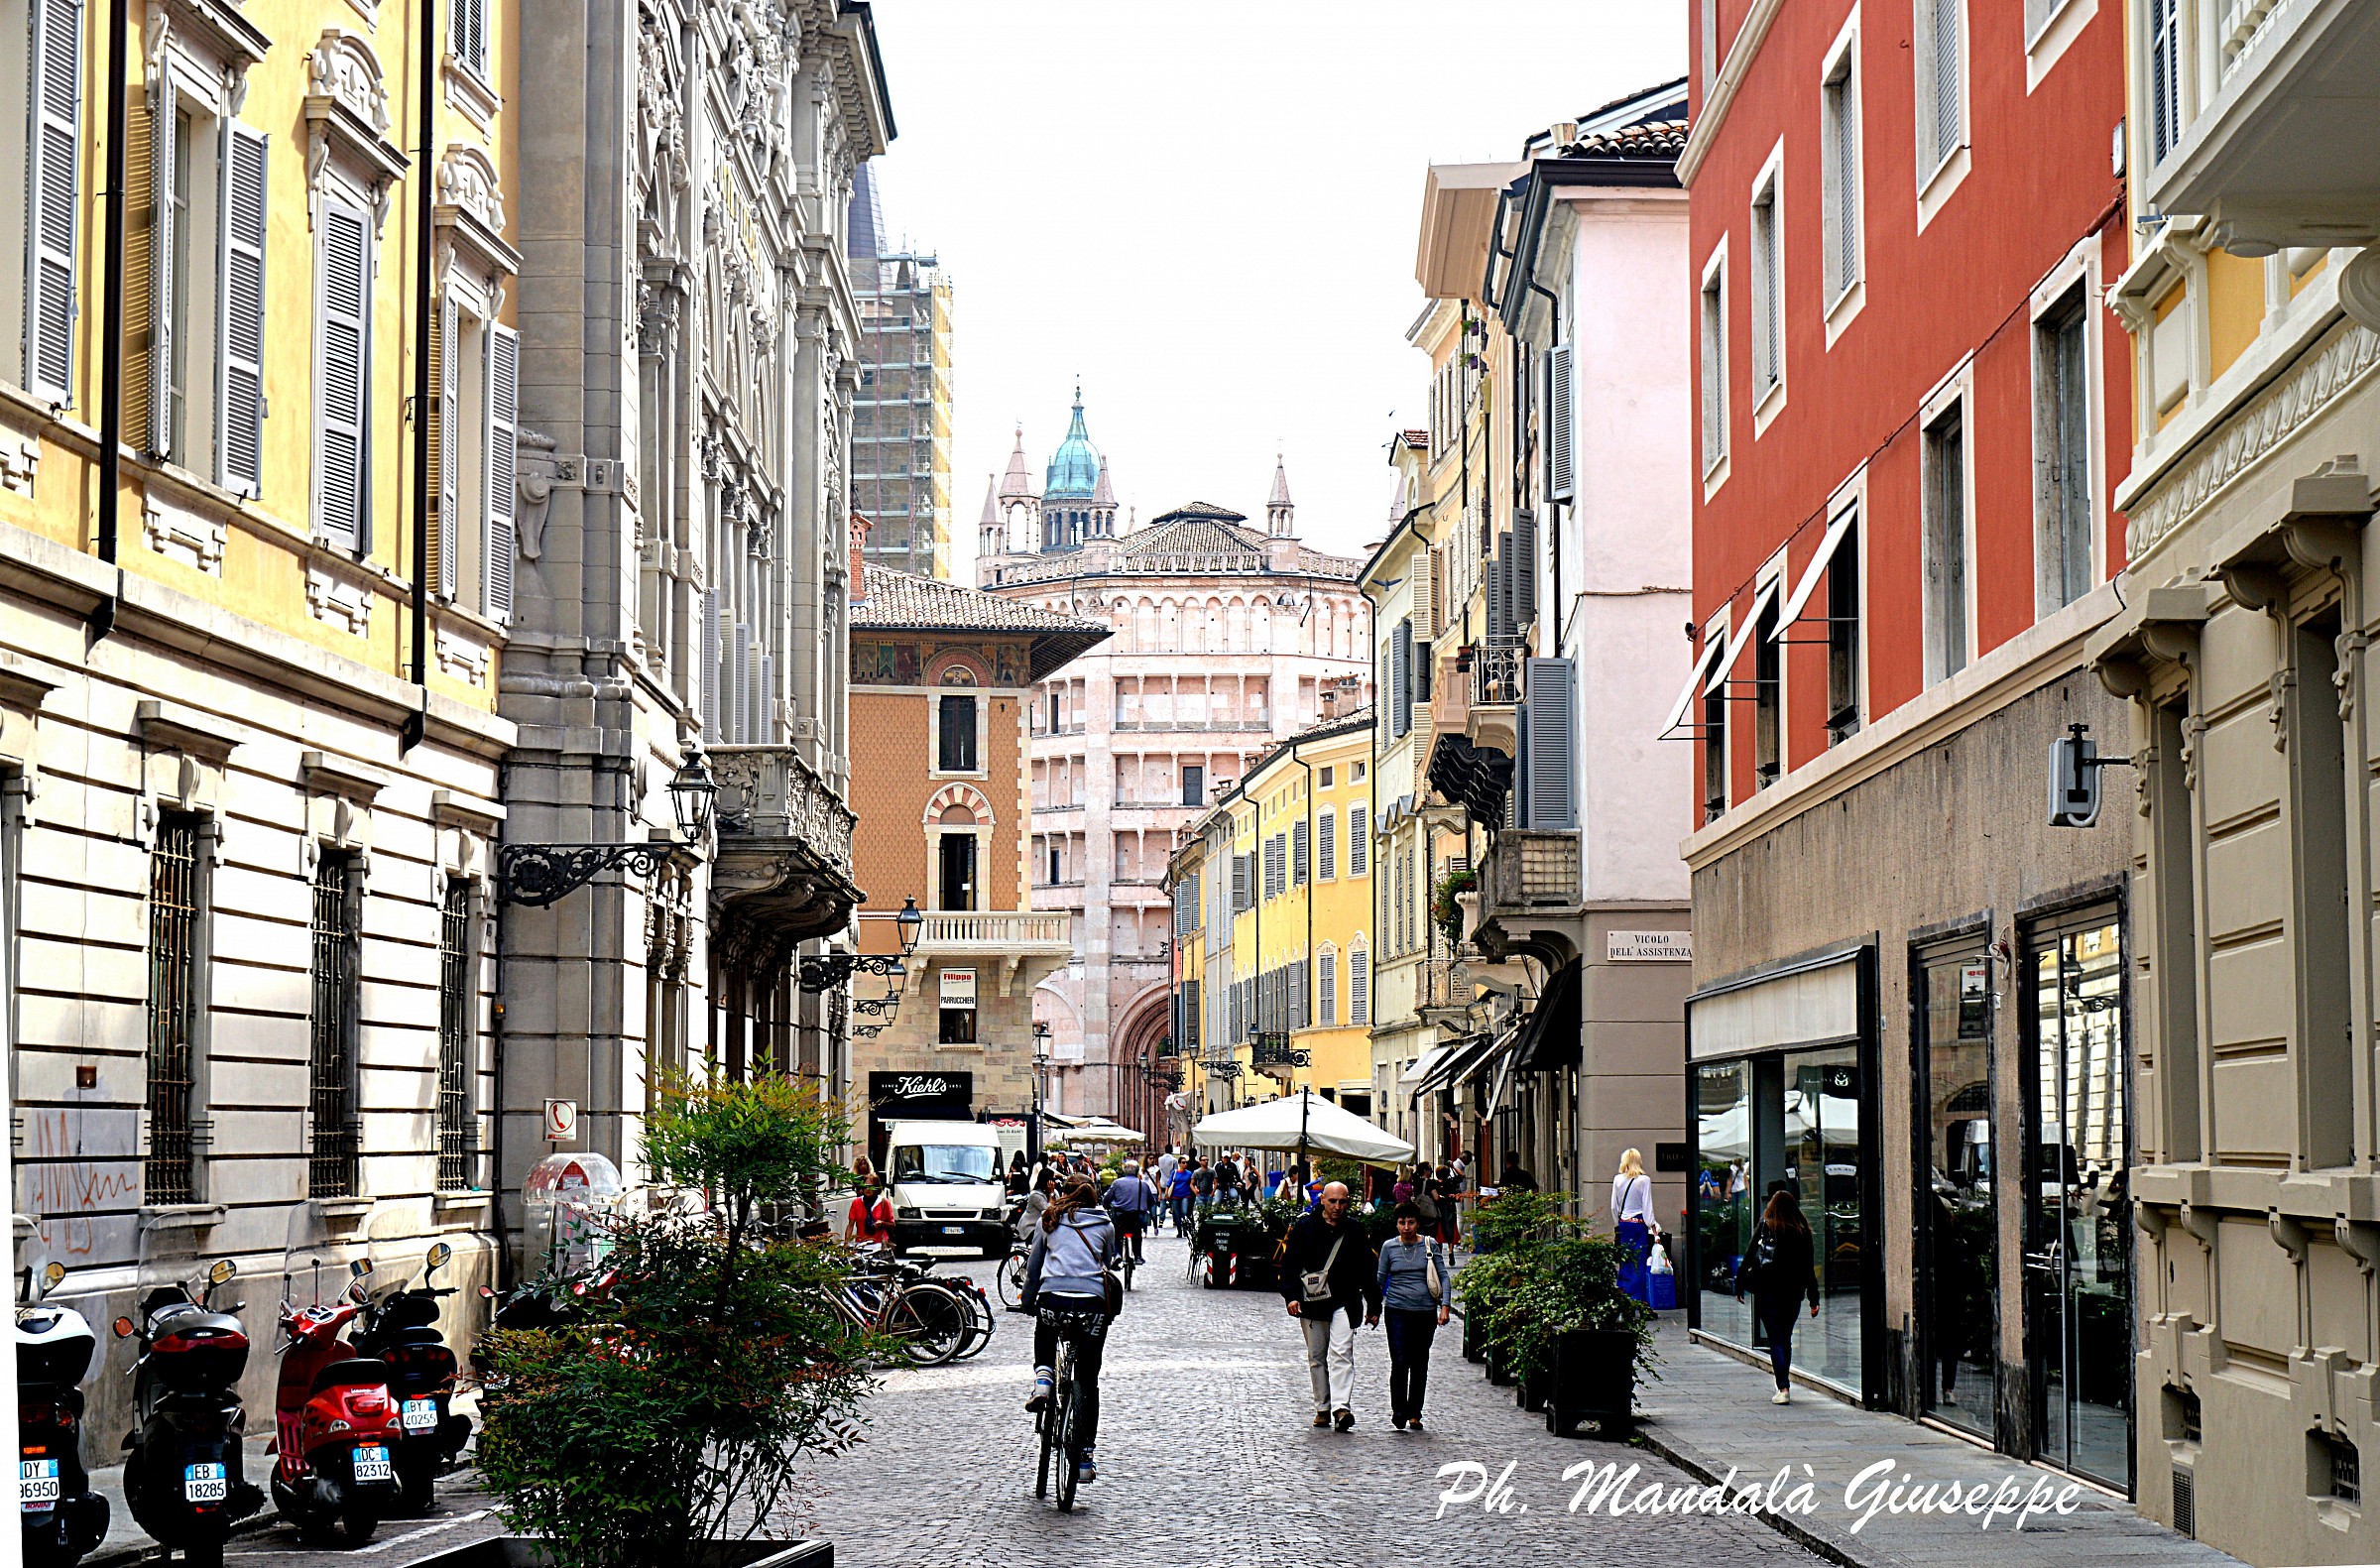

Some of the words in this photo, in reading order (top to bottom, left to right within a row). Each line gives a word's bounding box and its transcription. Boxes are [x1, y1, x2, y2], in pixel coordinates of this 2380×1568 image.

[1634, 935, 1669, 944] VICOLO
[1610, 946, 1633, 956] DELL'
[1636, 947, 1692, 957] ASSISTENZA
[943, 973, 972, 982] Filippo
[894, 1076, 947, 1094] Kiehl's
[410, 1401, 422, 1412] BY
[405, 1413, 436, 1425] 40255
[361, 1448, 376, 1461] DC
[24, 1462, 40, 1478] DY
[194, 1465, 210, 1479] EB
[356, 1464, 390, 1478] 82312
[188, 1482, 224, 1499] 18285
